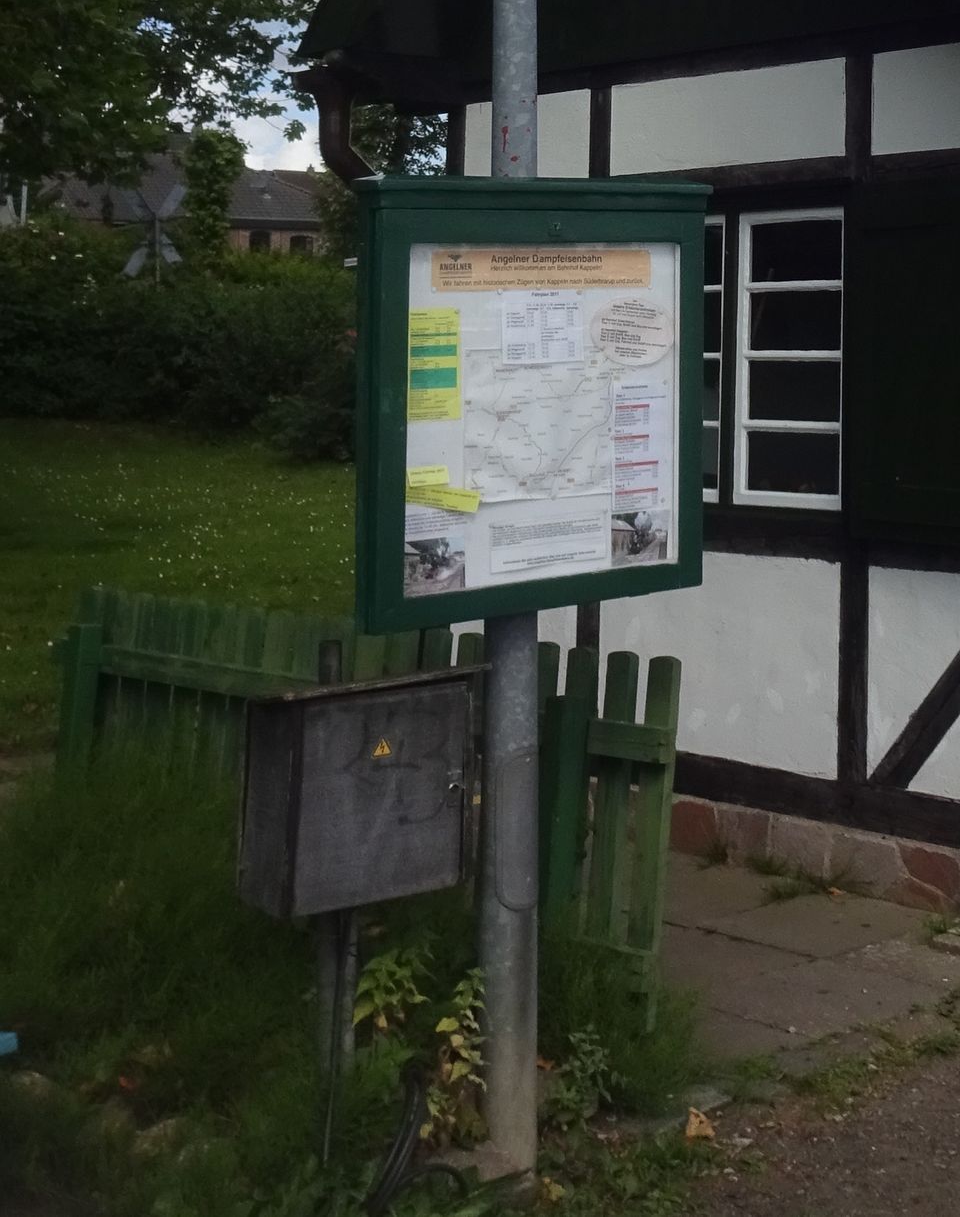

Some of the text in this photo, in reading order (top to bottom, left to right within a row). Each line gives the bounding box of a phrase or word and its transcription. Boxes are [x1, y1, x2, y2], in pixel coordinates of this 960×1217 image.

[491, 254, 602, 265] Angelner Dampfeisenbahn
[440, 263, 472, 271] ANGELNER
